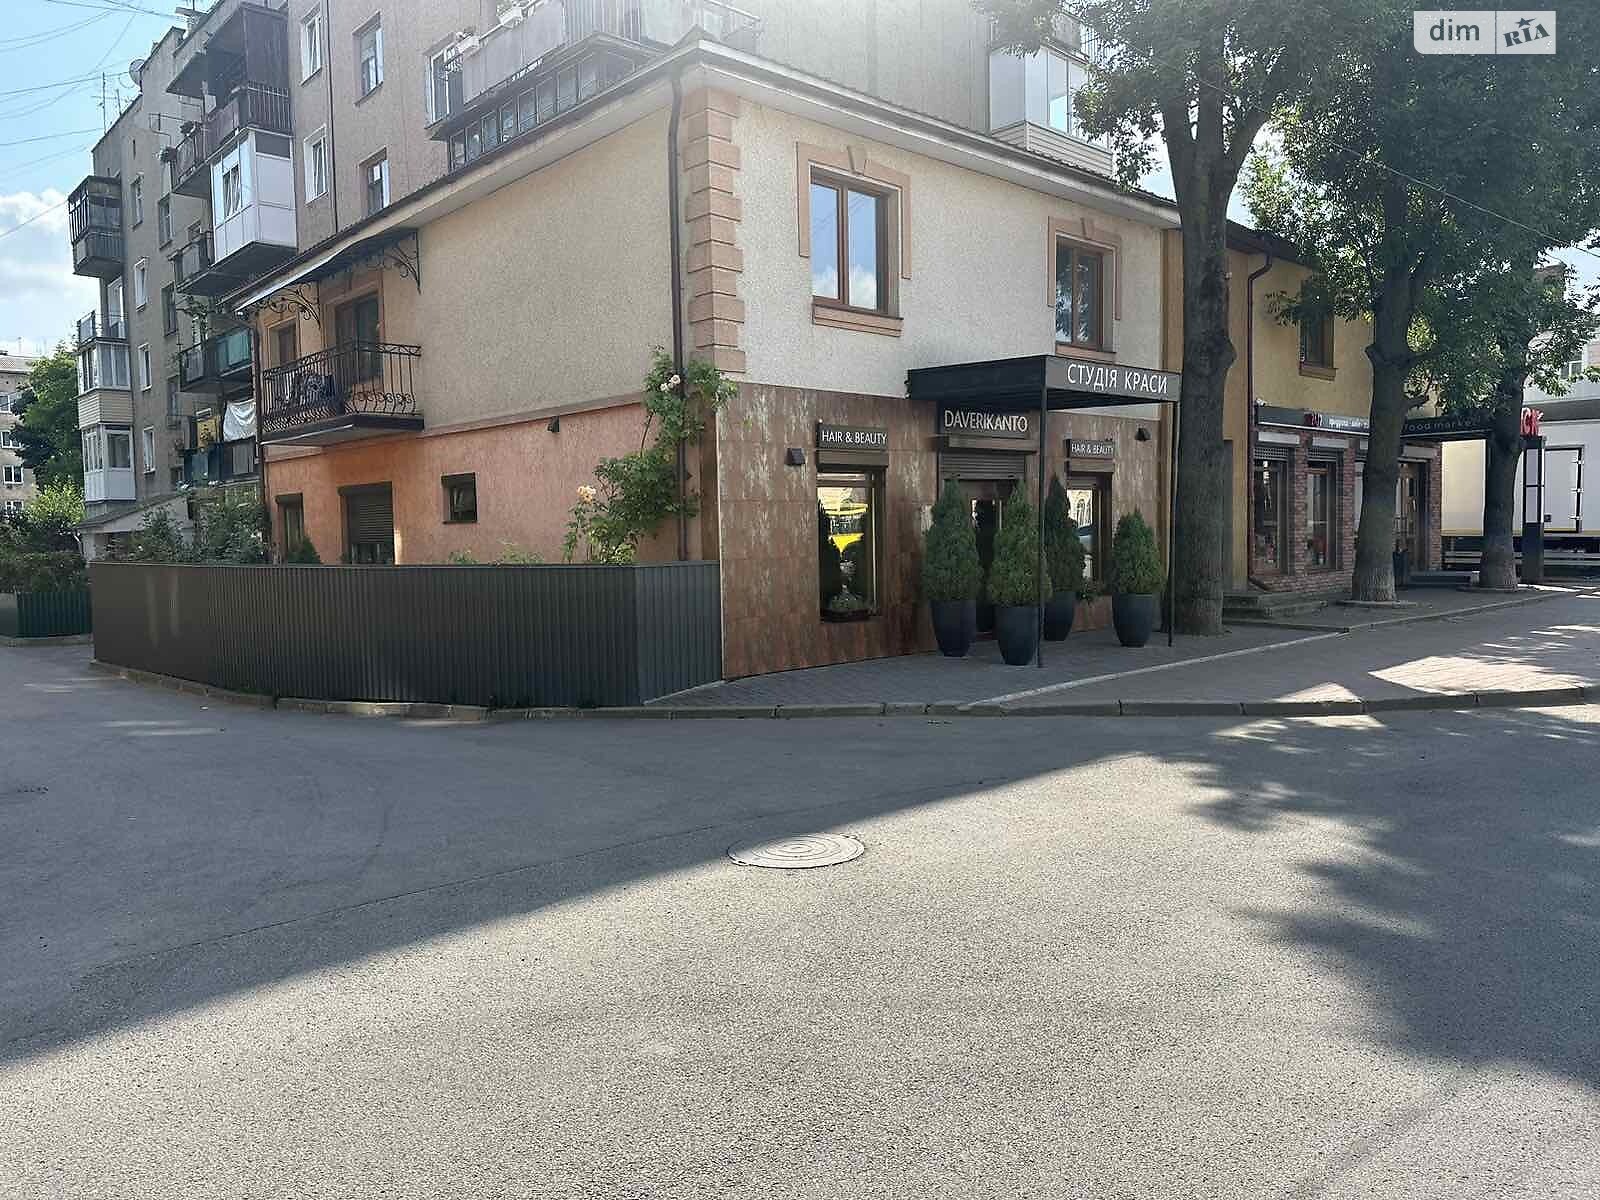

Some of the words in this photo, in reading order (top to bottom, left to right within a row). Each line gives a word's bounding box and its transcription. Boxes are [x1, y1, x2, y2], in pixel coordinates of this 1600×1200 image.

[1067, 363, 1118, 391] СТУДІЯ
[1125, 371, 1168, 394] КРАСИ
[944, 410, 1028, 433] DAVERIKANTO
[822, 430, 843, 442] HAIR
[845, 431, 853, 443] &
[854, 431, 887, 445] BEAUTY
[1071, 443, 1086, 454] HAIR
[1093, 445, 1114, 456] BEAUTY
